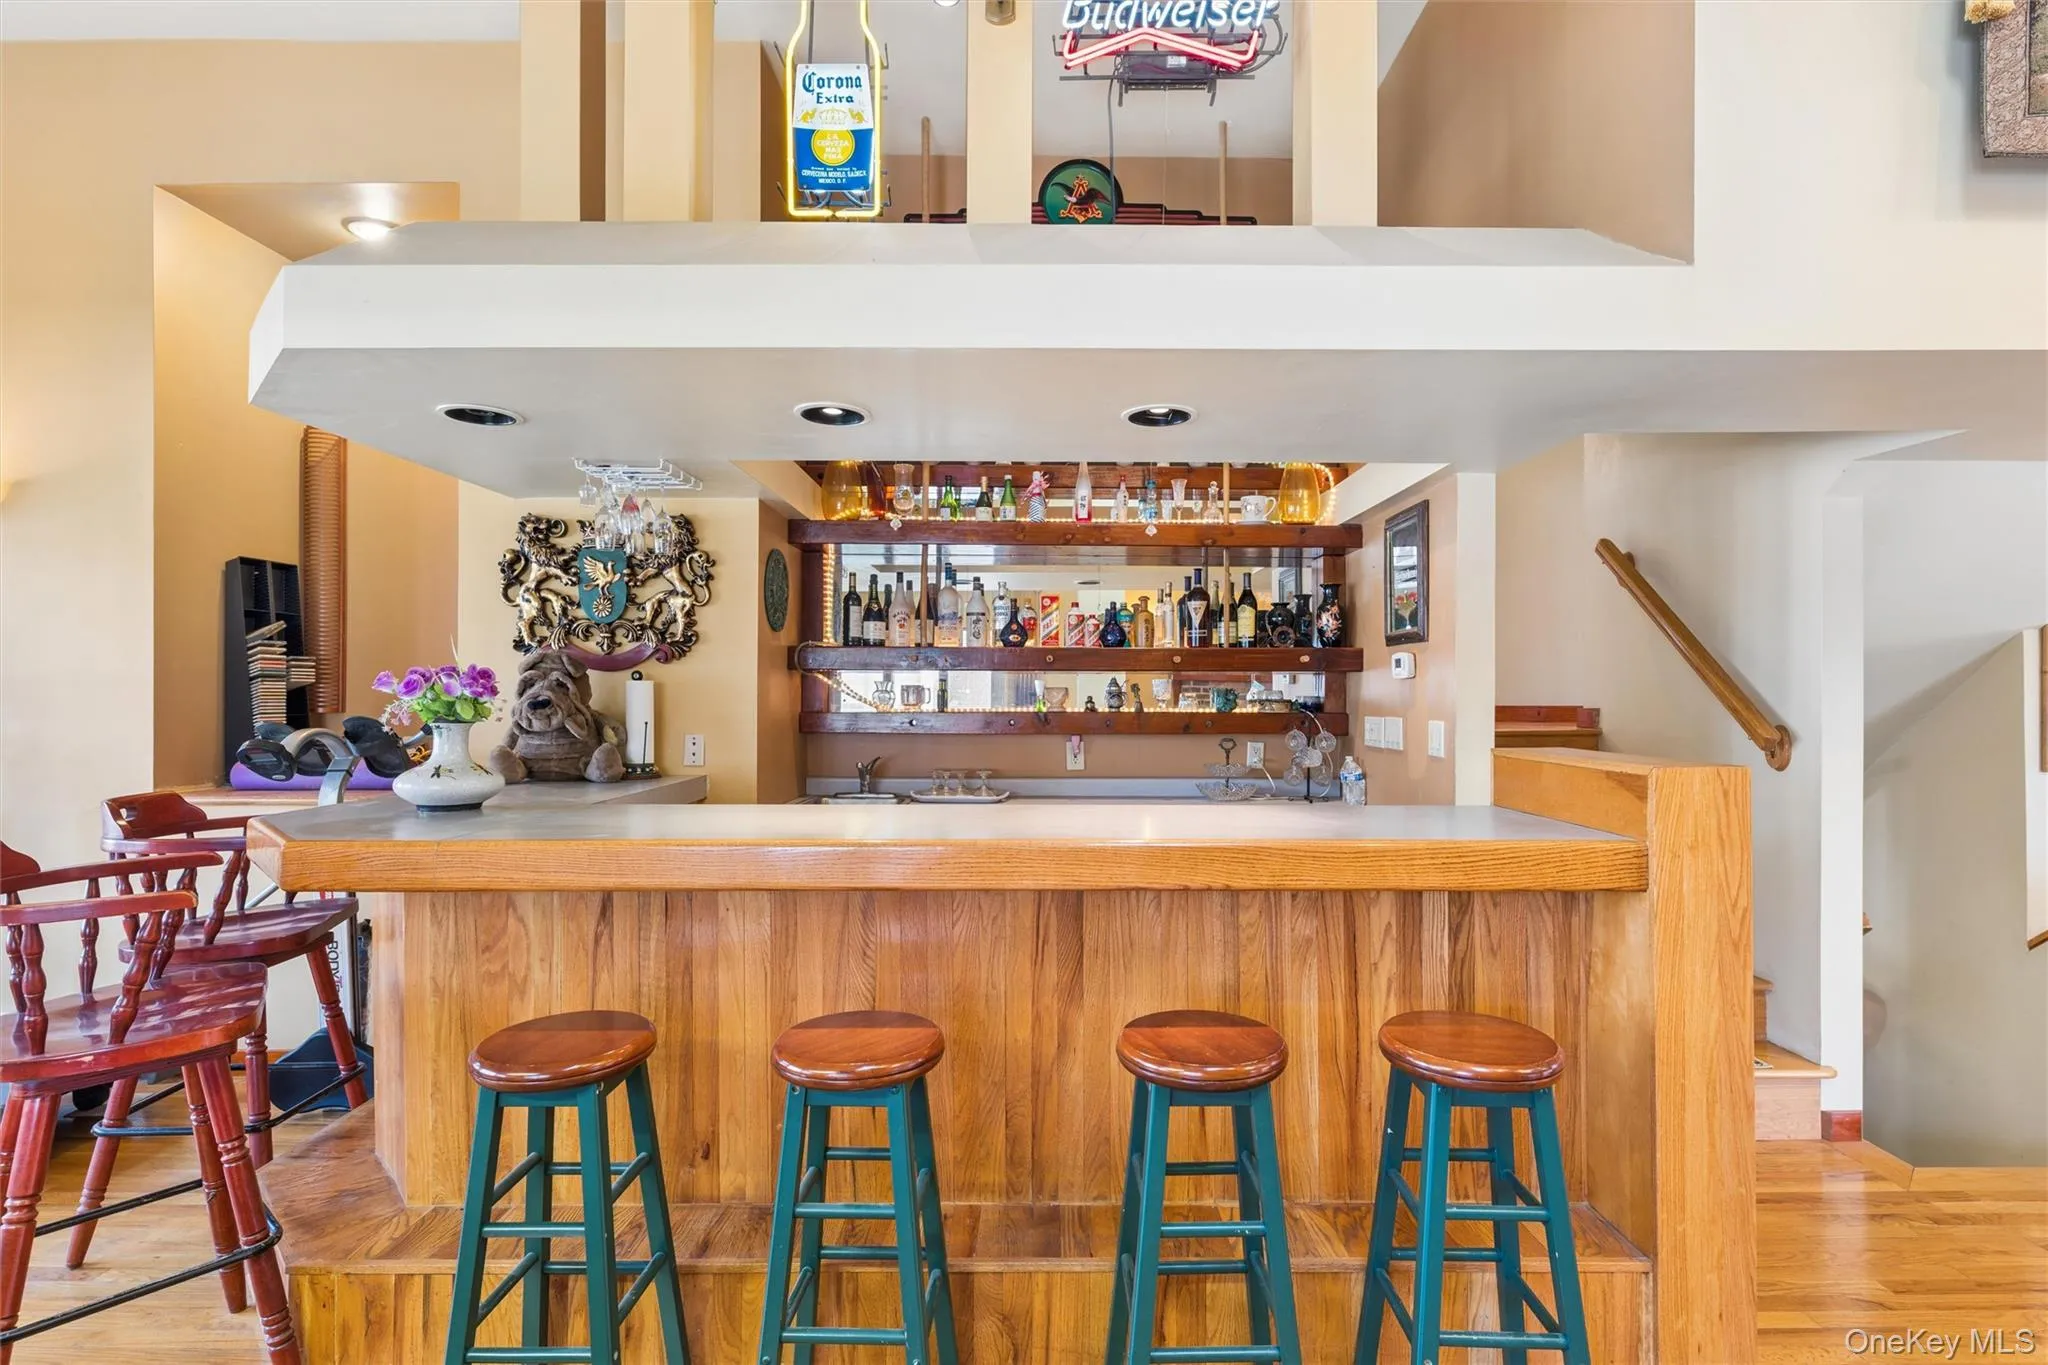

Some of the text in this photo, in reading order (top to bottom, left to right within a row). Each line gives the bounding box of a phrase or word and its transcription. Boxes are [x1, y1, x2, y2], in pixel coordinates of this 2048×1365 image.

[1062, 0, 1272, 30] Budweiser
[802, 72, 863, 95] Corona
[816, 92, 855, 105] Extra
